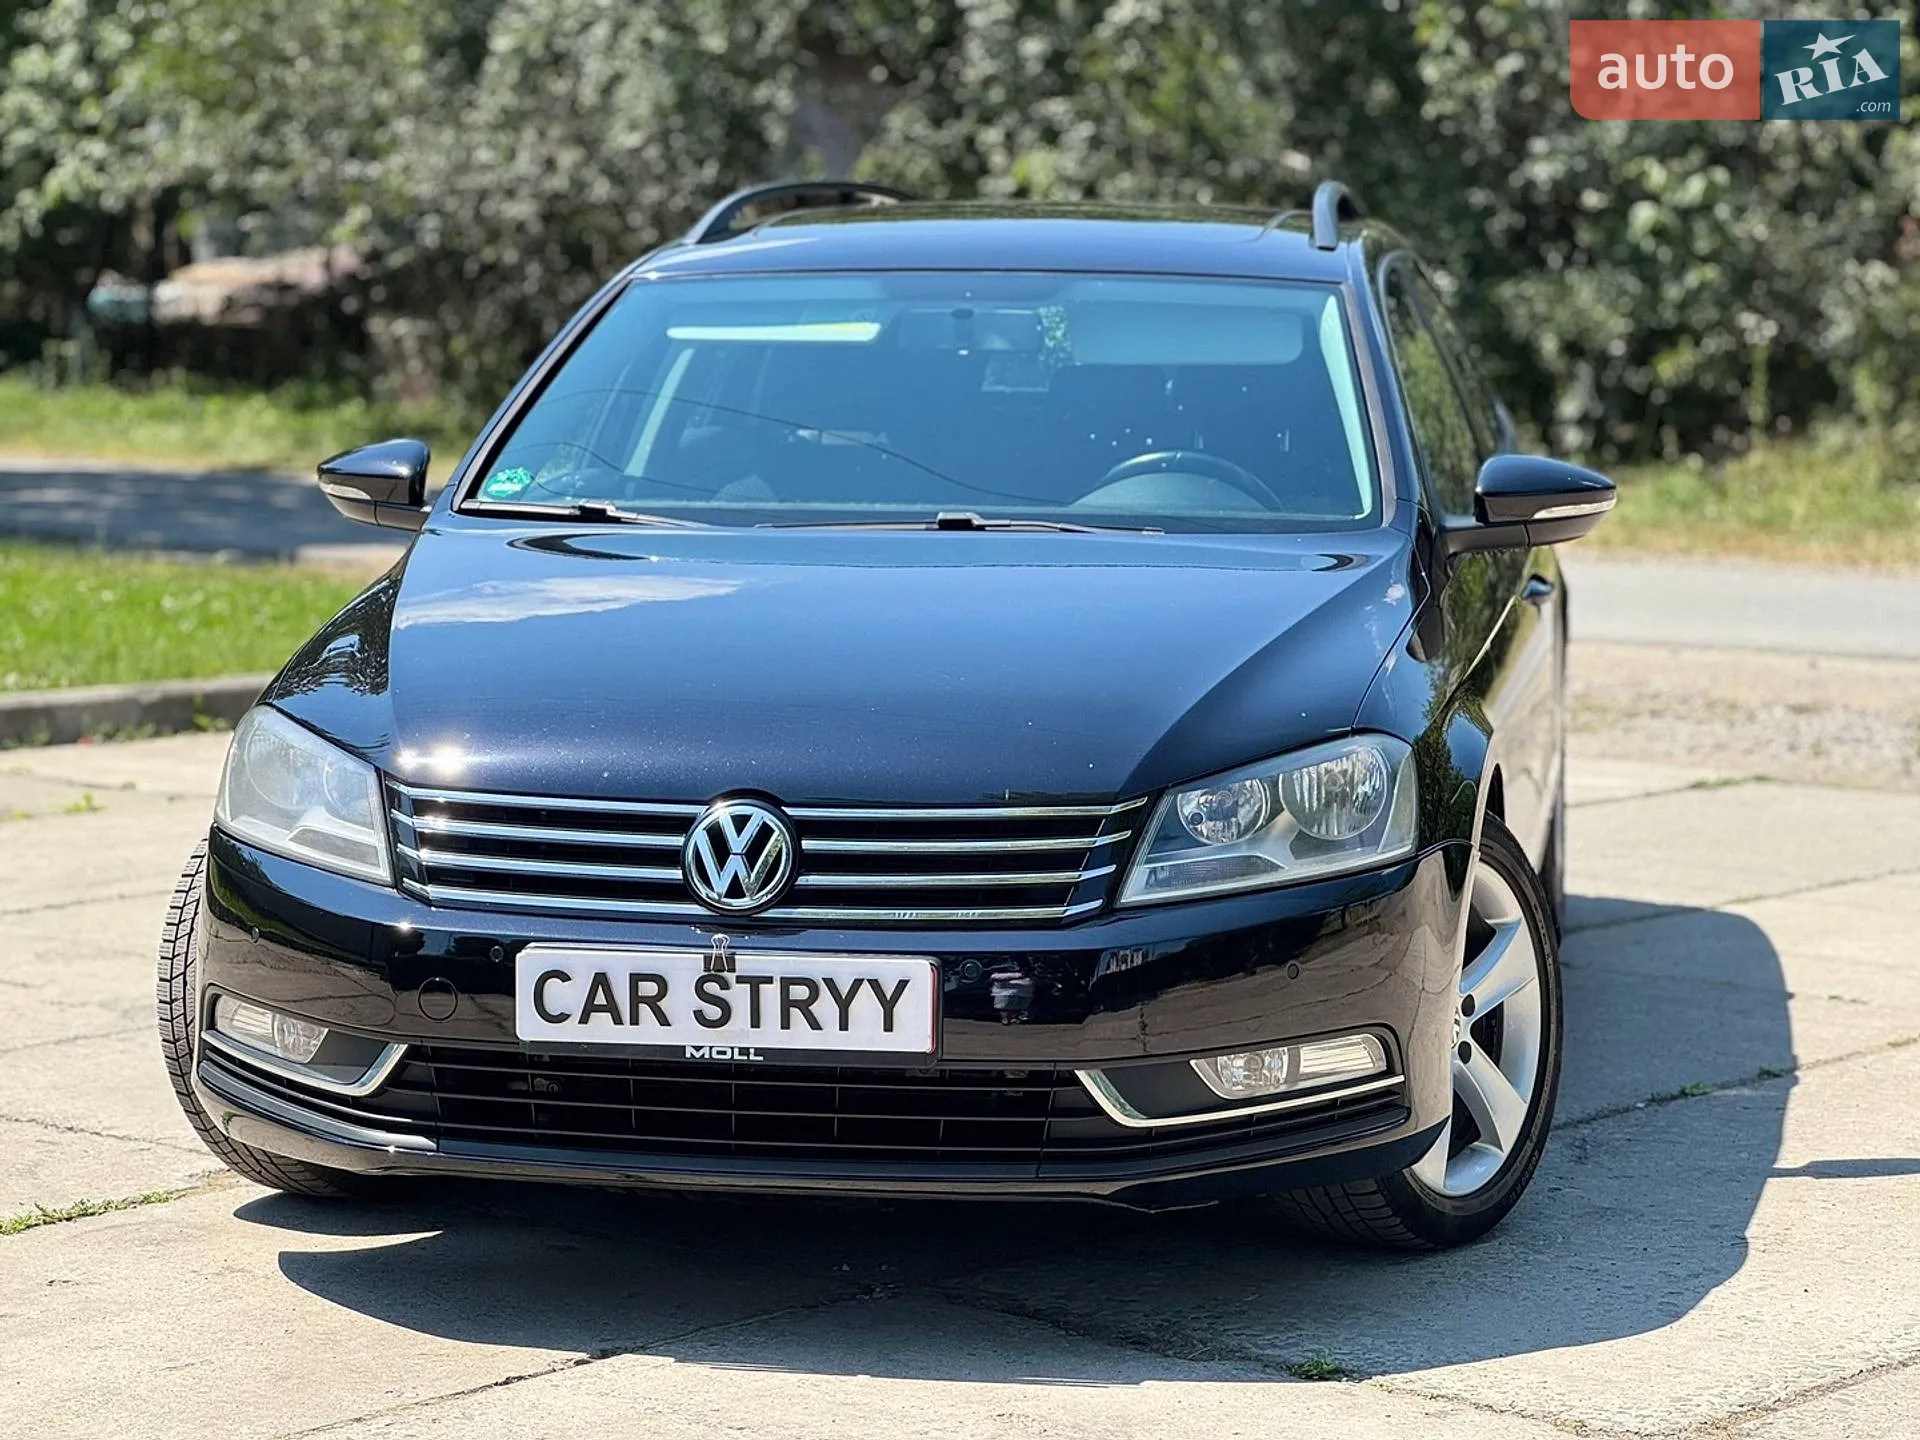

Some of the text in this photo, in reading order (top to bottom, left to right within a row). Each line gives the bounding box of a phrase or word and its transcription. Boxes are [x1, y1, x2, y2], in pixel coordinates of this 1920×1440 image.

[533, 969, 910, 1033] CAR STRYY
[685, 1044, 764, 1061] MOLL
